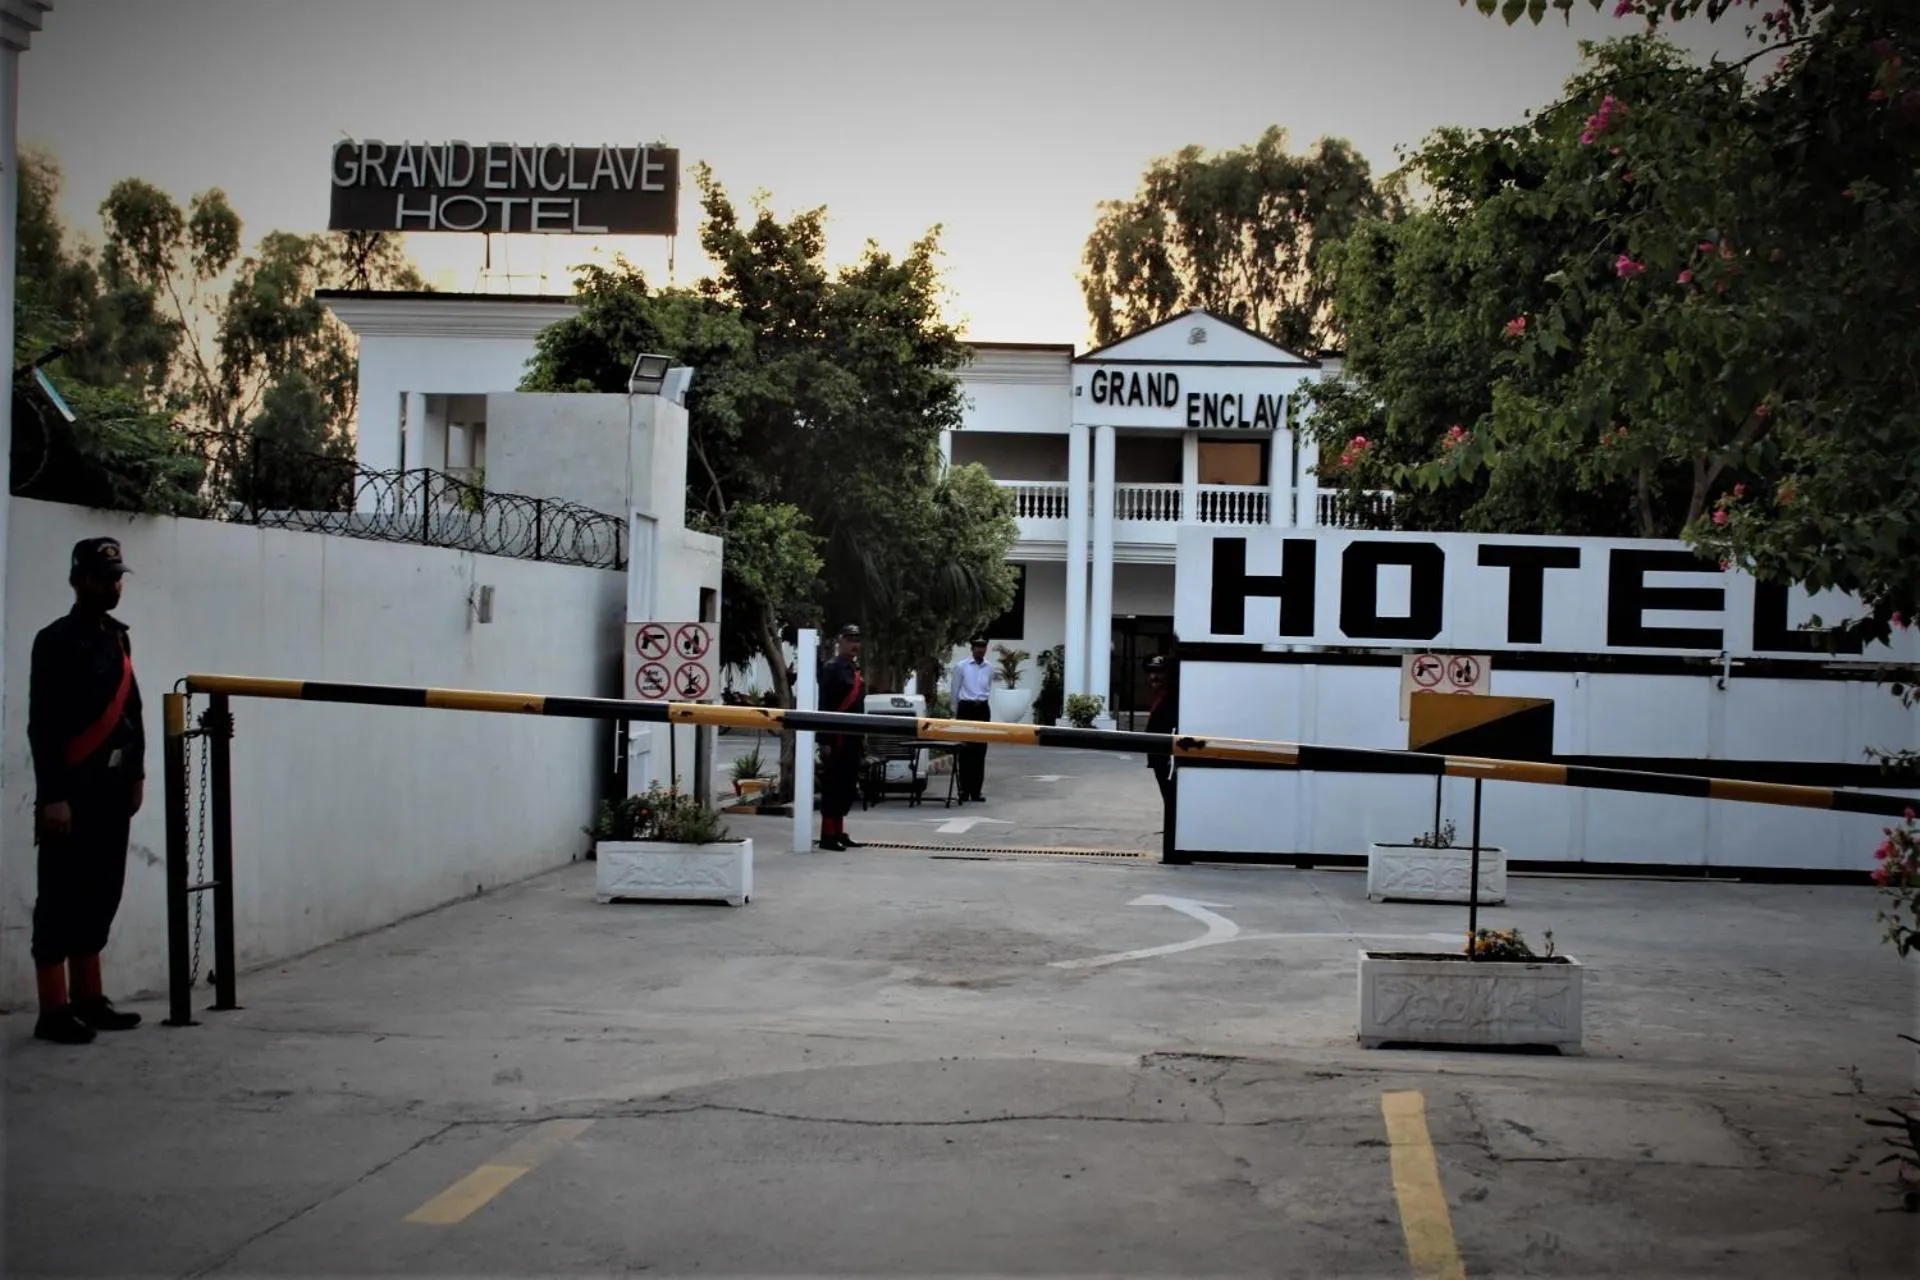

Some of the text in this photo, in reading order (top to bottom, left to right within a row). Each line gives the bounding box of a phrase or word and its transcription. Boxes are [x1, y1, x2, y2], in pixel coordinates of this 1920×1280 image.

[331, 138, 666, 192] GRAND ENCLAVE
[395, 193, 609, 234] HOTEL
[1091, 369, 1180, 408] GRAND
[1210, 536, 1864, 655] HOTEL
